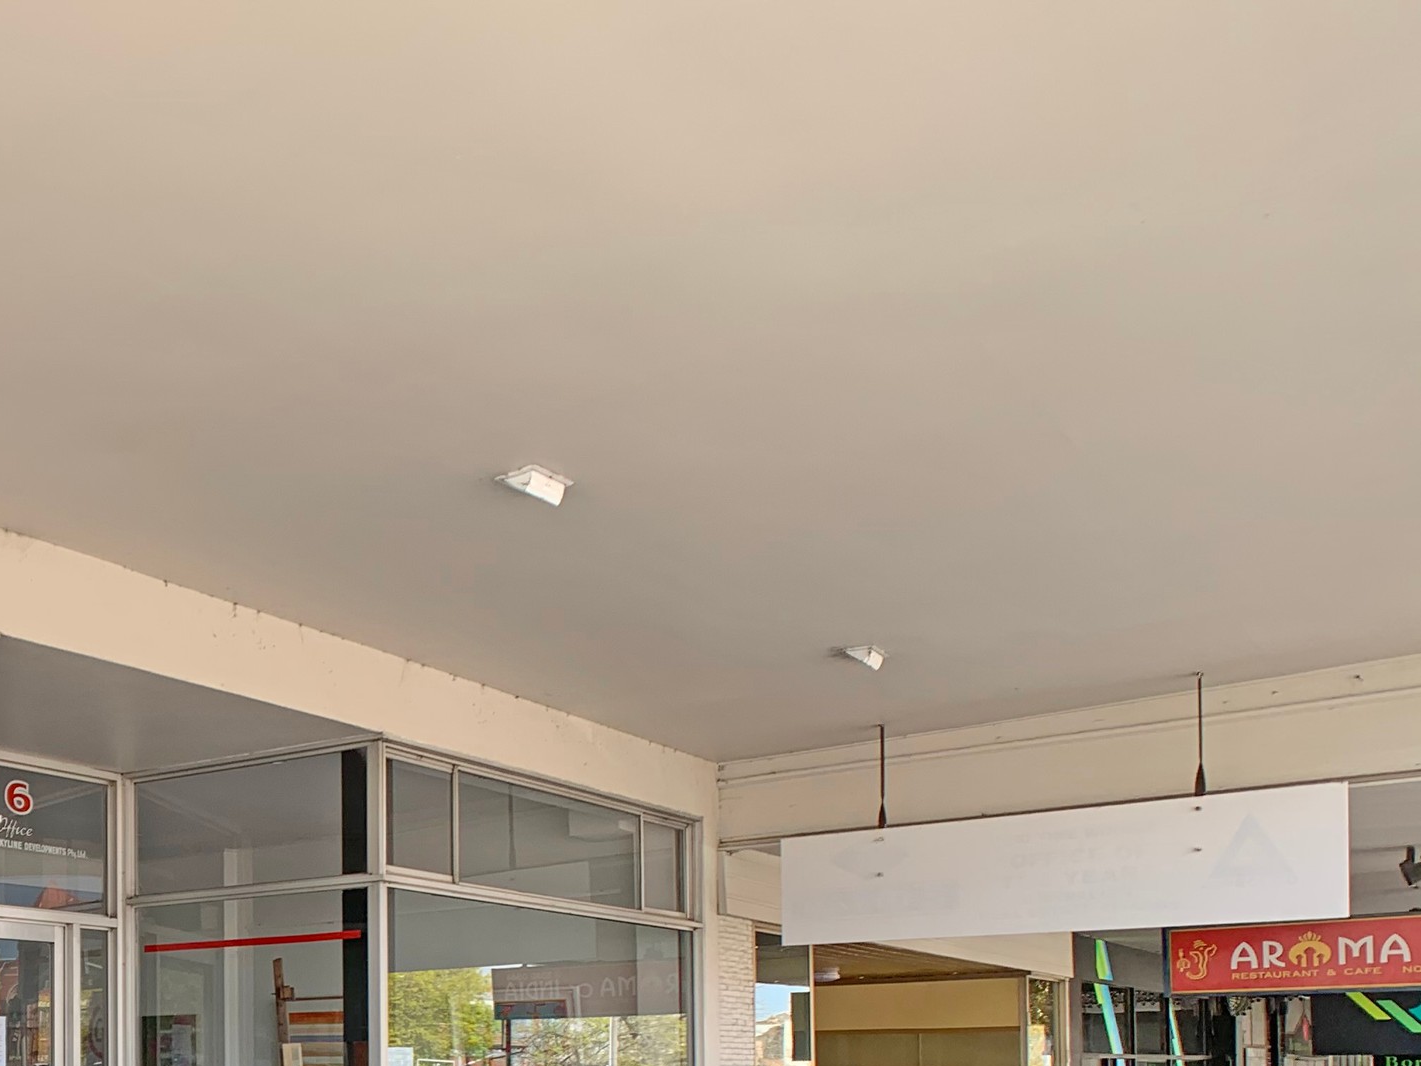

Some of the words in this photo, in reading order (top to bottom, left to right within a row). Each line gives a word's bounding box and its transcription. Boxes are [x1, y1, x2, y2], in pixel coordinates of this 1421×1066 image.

[24, 842, 67, 857] DEVELOPMENTS
[1230, 930, 1412, 971] AROMA
[1231, 968, 1320, 981] RESTAURANT
[1326, 968, 1337, 977] &
[1343, 966, 1383, 976] CAFE
